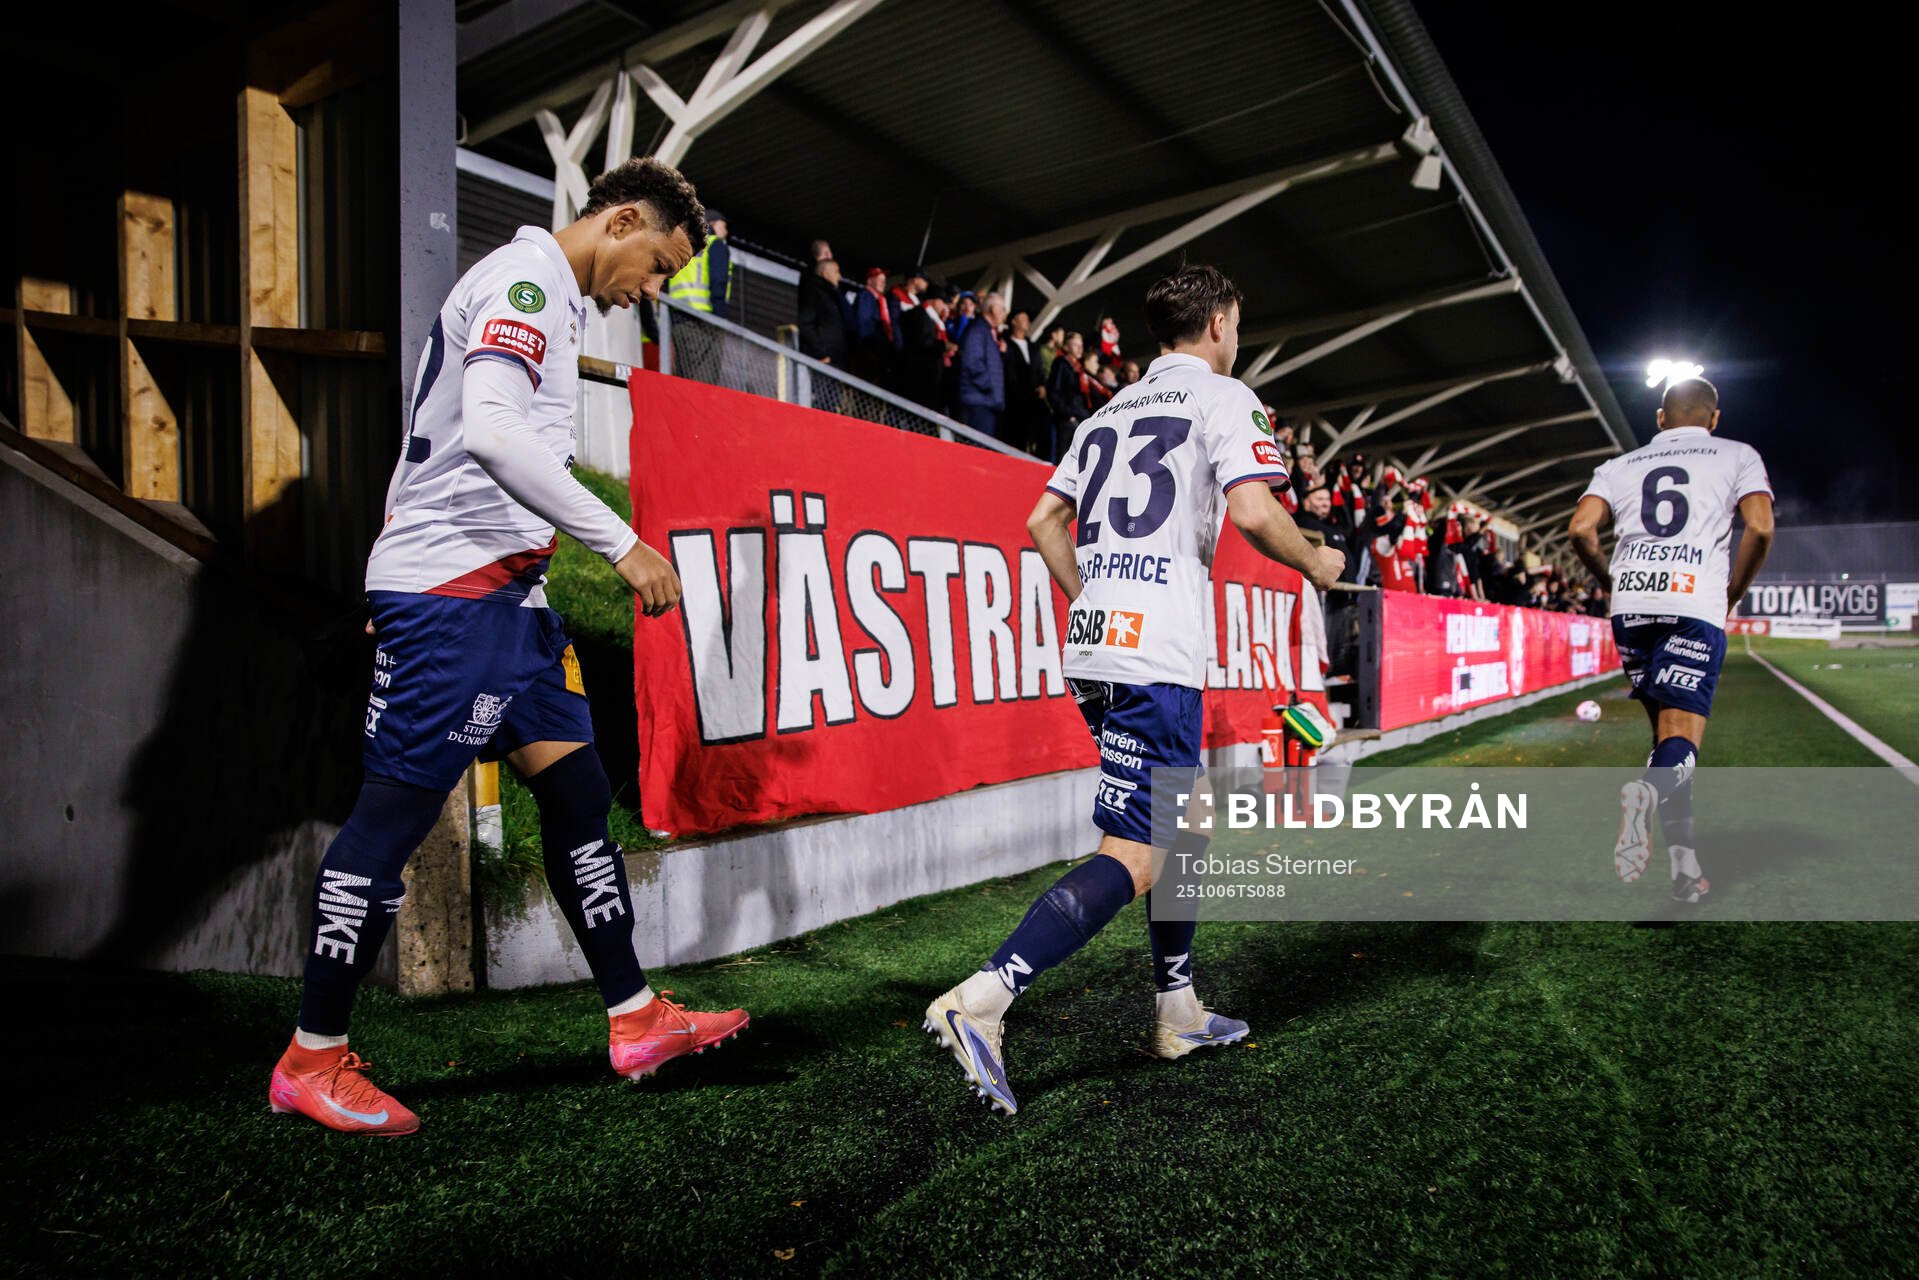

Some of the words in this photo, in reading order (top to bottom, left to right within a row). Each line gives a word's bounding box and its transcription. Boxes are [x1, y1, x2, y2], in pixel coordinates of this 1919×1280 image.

[489, 323, 545, 352] UNIBET
[1076, 416, 1192, 548] 23
[1641, 466, 1689, 538] 6
[667, 489, 1066, 746] VÄSTRA
[1618, 571, 1669, 592] BESAB
[1749, 584, 1879, 615] TOTALBYGG
[1067, 609, 1106, 645] ESAB
[314, 869, 372, 965] MIKE
[569, 838, 626, 929] MIKE
